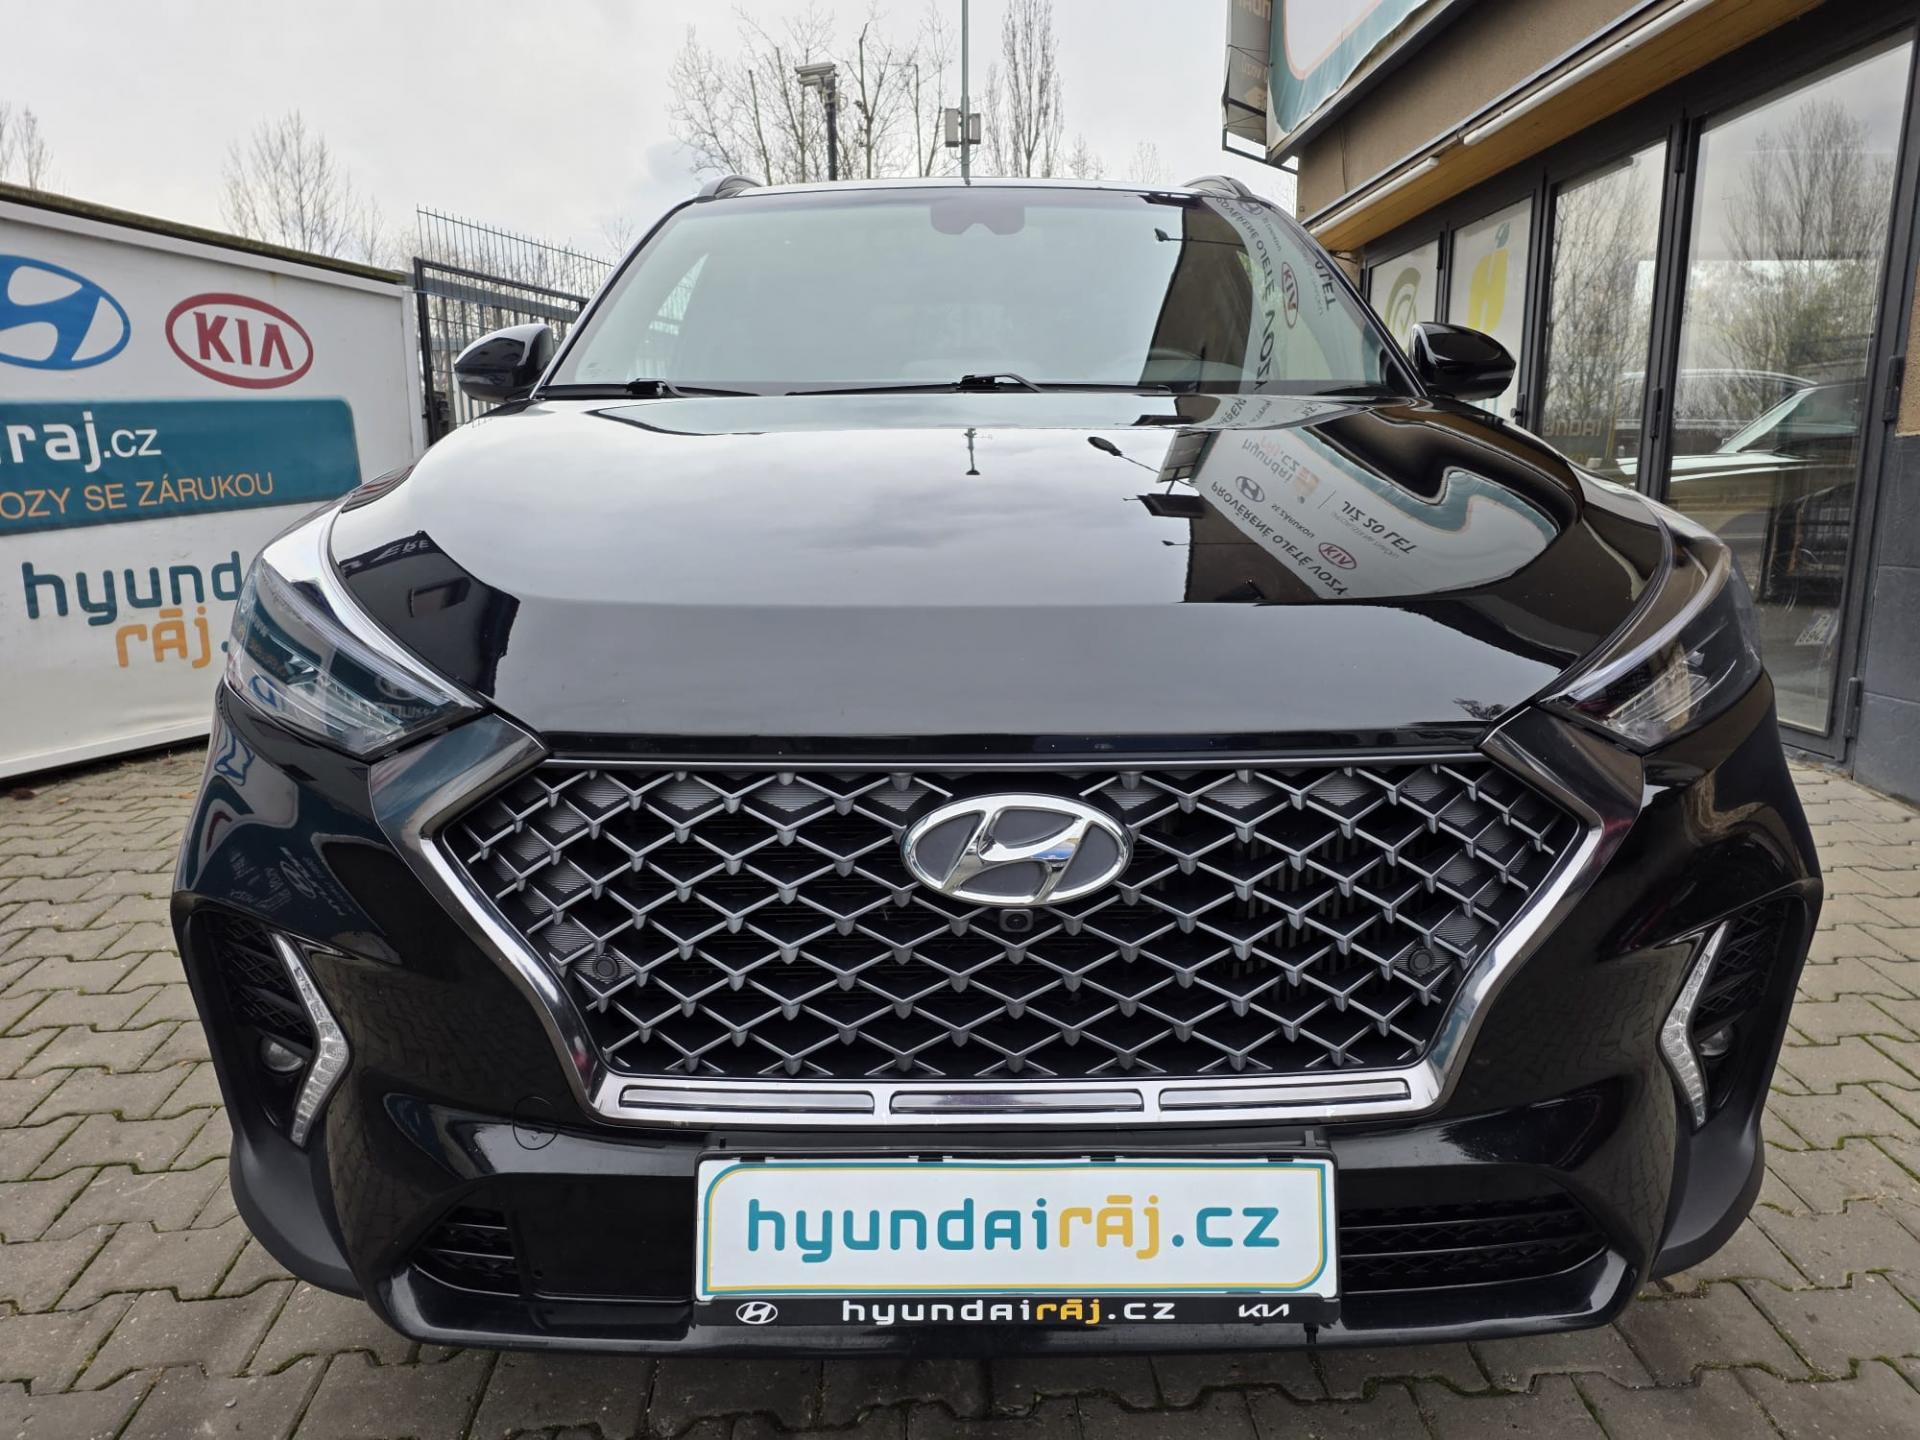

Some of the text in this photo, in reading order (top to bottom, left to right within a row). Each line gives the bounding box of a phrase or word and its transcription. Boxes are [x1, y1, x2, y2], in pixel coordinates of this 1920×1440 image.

[193, 310, 293, 370] KIA
[0, 410, 161, 473] raj.cz
[83, 483, 128, 511] SE
[136, 472, 274, 506] ZÁRUKOU
